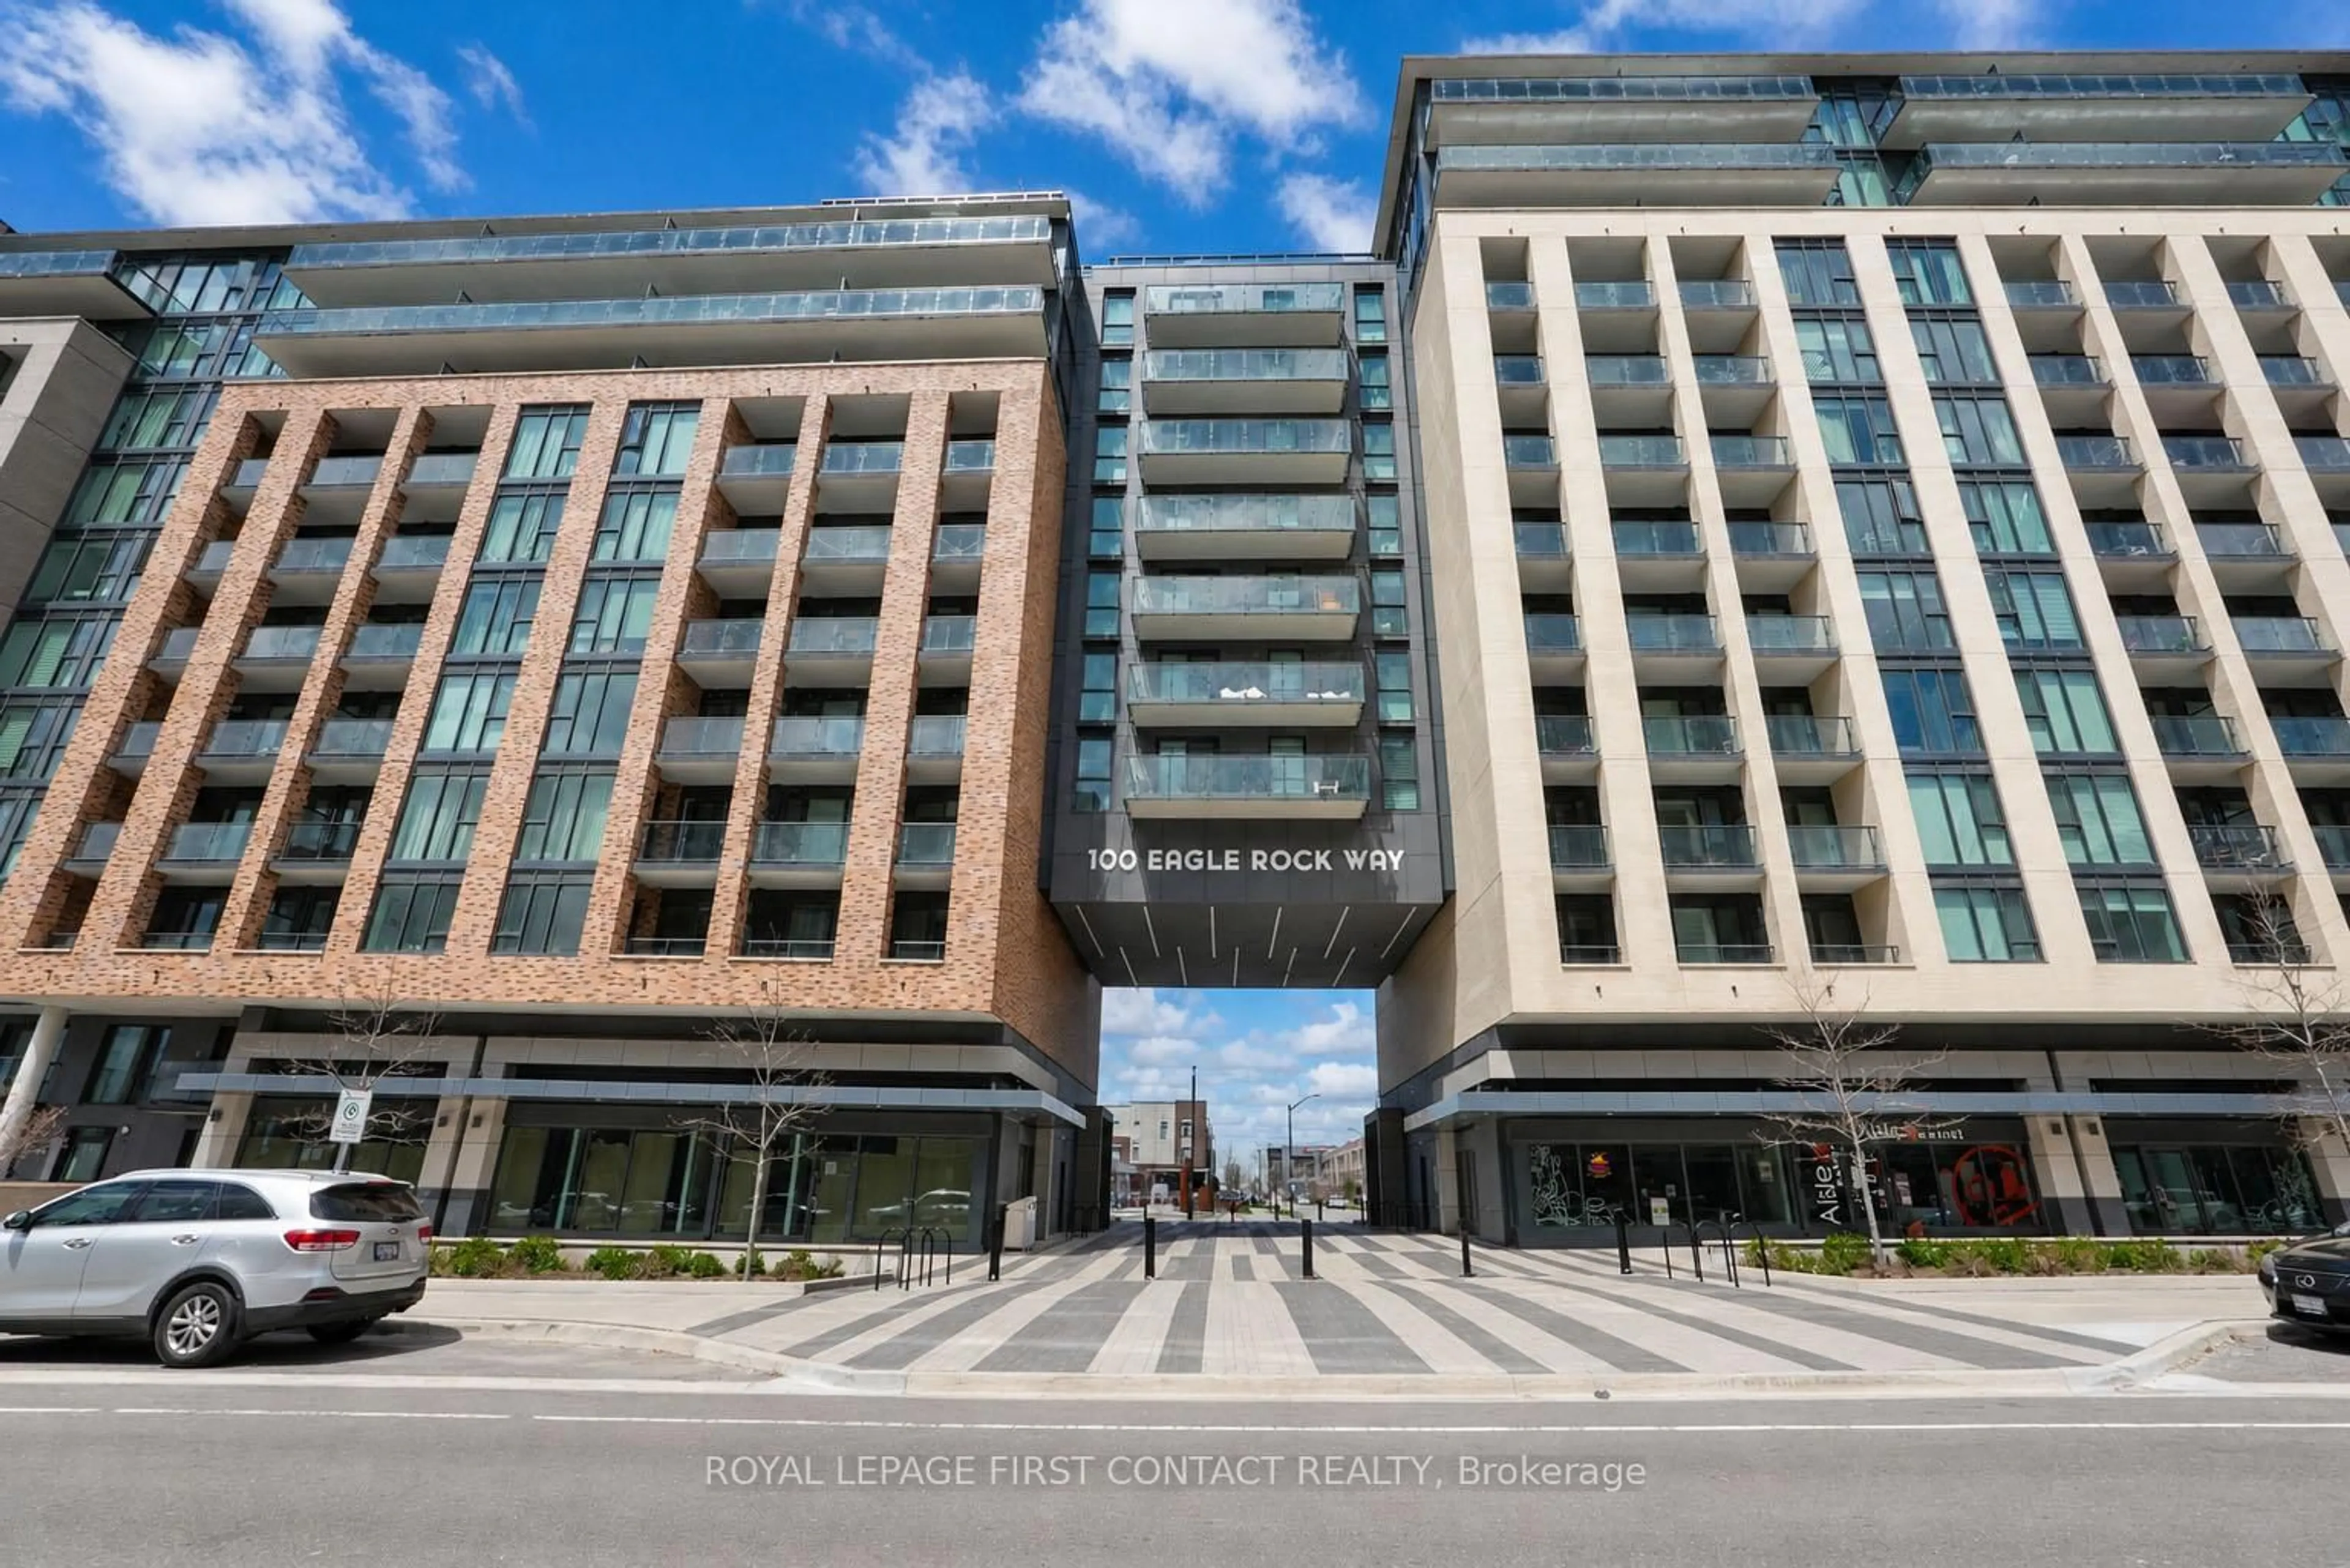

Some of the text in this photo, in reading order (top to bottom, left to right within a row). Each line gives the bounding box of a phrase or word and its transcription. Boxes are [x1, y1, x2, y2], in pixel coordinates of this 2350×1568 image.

[1088, 848, 1405, 871] 100 EAGLE ROCK WAY
